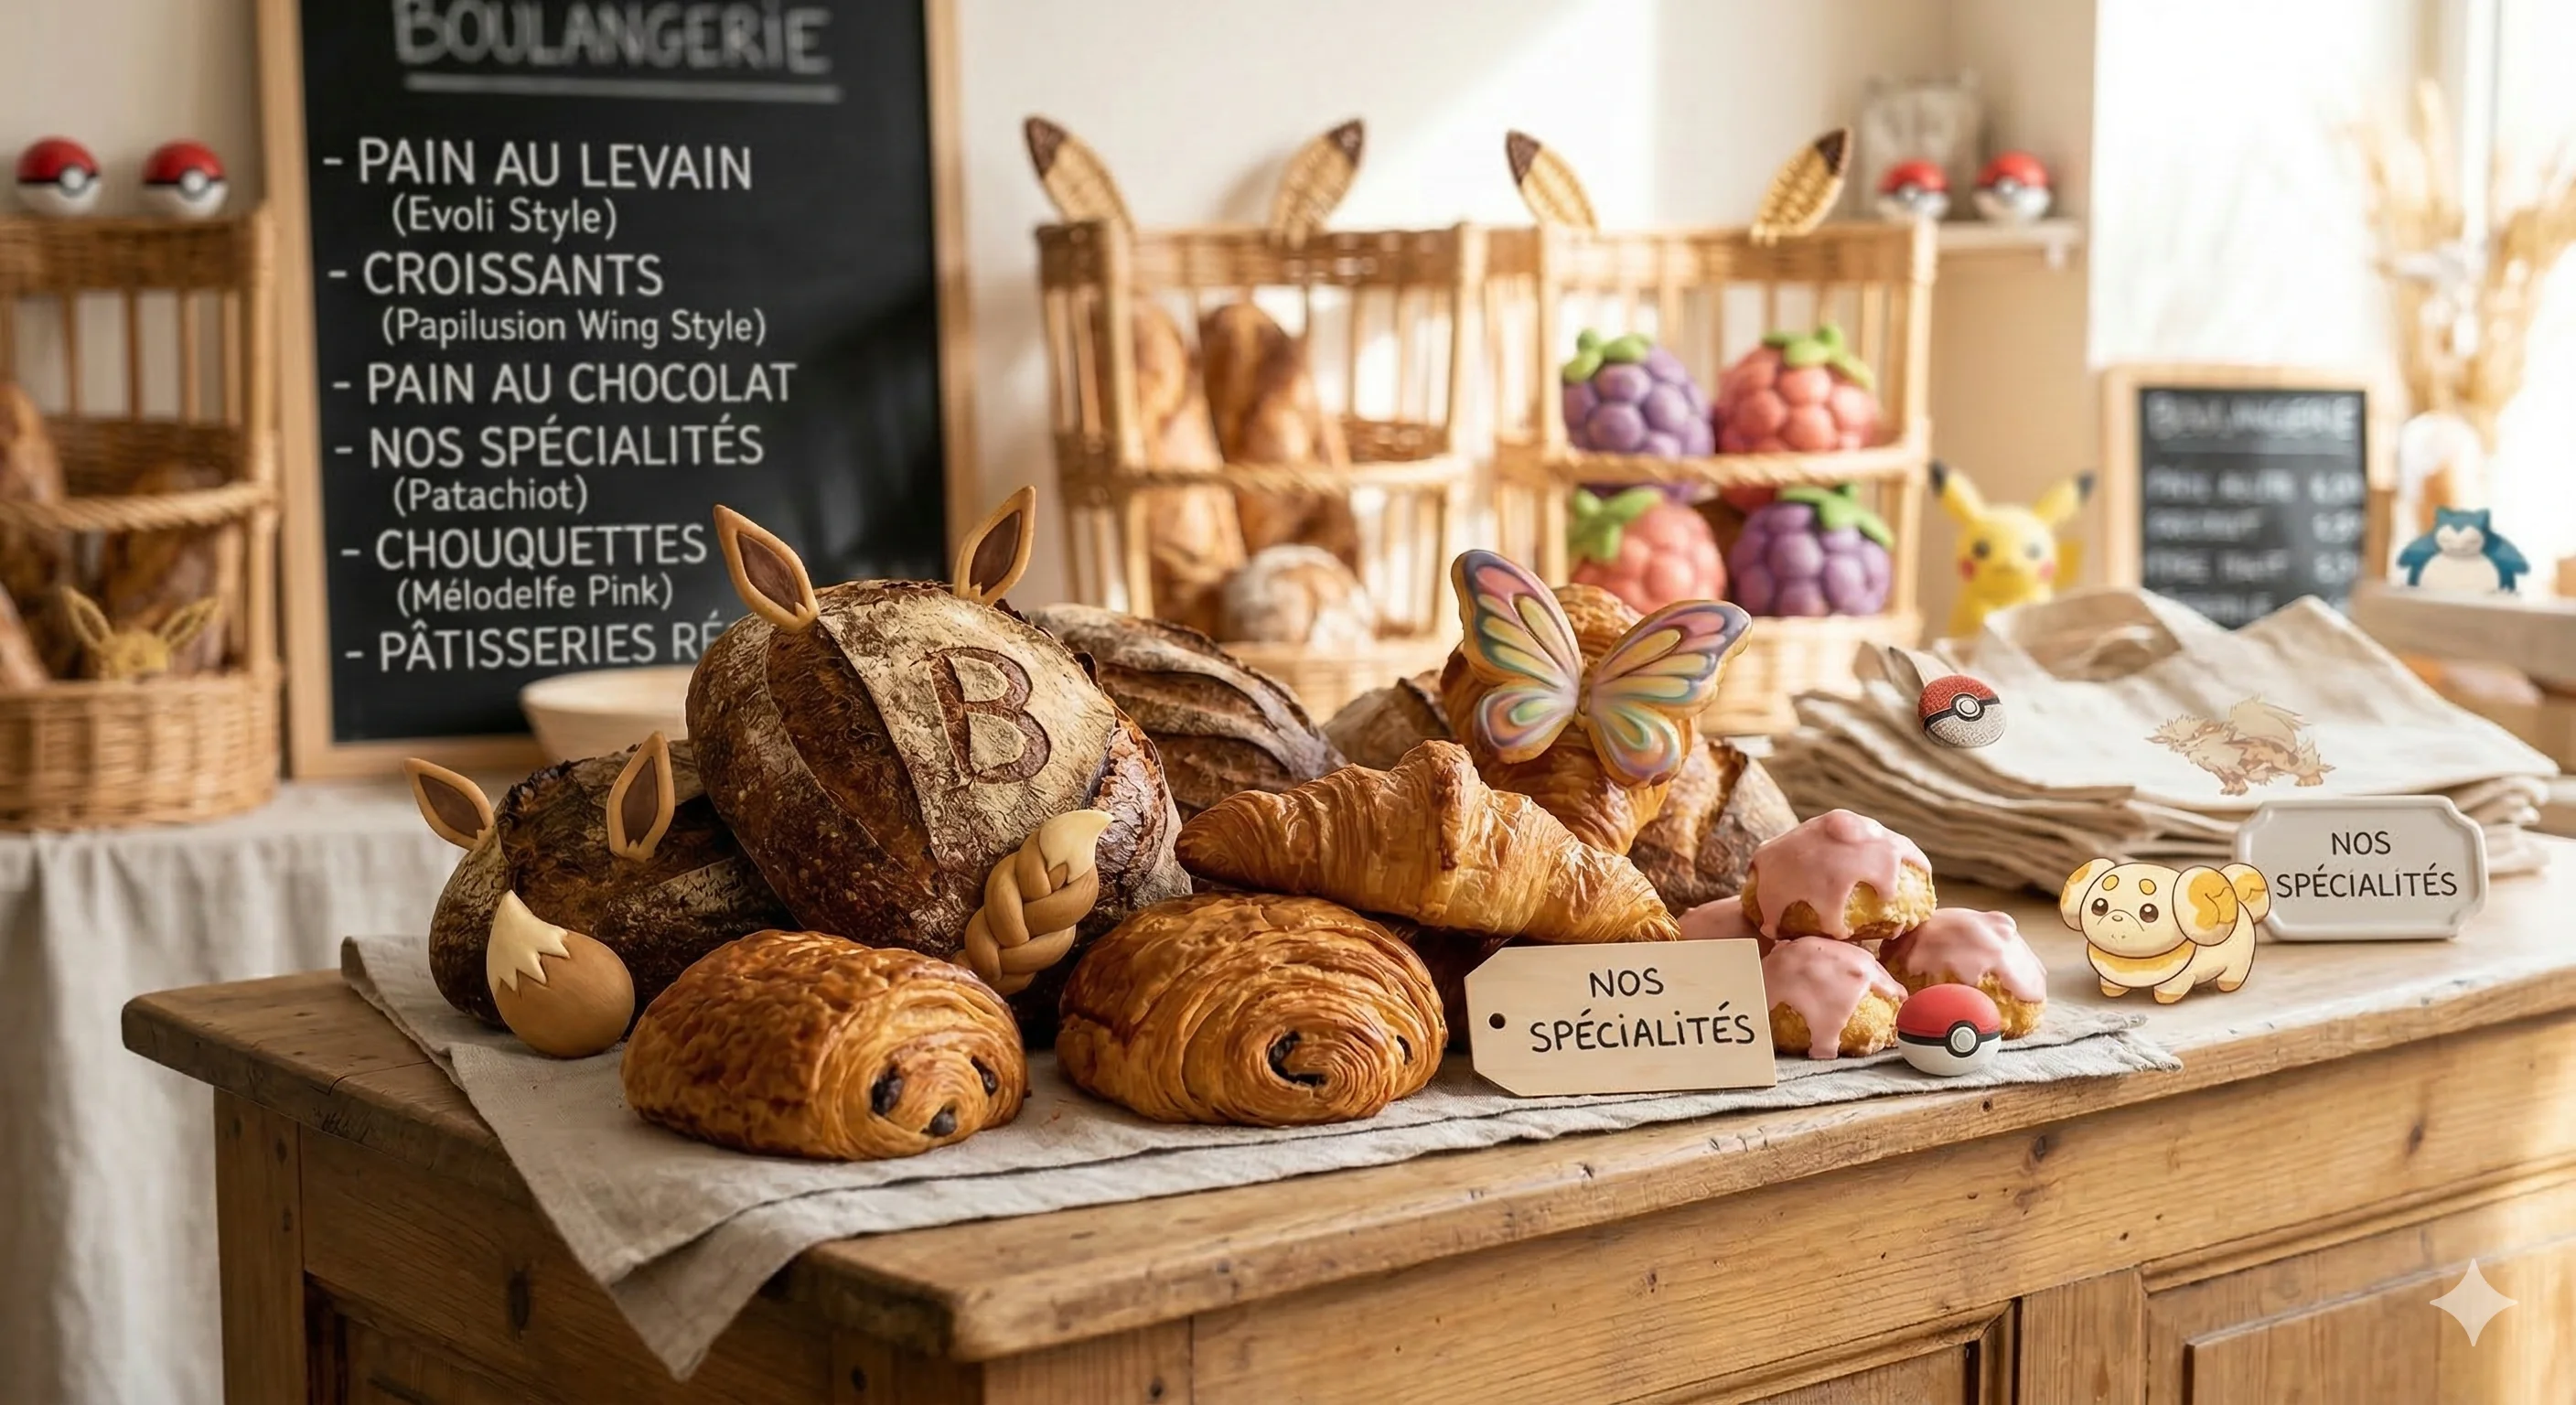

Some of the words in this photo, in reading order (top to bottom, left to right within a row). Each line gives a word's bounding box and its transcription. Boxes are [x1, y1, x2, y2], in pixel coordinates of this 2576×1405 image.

[359, 137, 476, 185] PAIN
[494, 141, 560, 188] AU
[580, 142, 752, 191] LEVAIN
[392, 193, 494, 237] (Evoli
[509, 196, 617, 243] Style)
[363, 251, 664, 297] CROISSANTS
[381, 306, 566, 350] (Papilusion
[576, 307, 660, 351] Wing
[671, 306, 767, 351] Style)
[368, 362, 475, 404] PAIN
[491, 362, 552, 404] AU
[568, 361, 798, 404] CHOCOLAT
[370, 425, 465, 469] NOS
[479, 412, 765, 468] SPÉCIALITÉS
[393, 473, 588, 518] (Patachiot)
[375, 522, 708, 571] CHOUQUETTES
[397, 574, 576, 617] (Mélodelfe
[588, 572, 673, 611] Pink)
[380, 619, 658, 672] PÂTISSERIES
[928, 645, 1053, 785] B
[2330, 830, 2392, 857] NOS
[1588, 966, 1665, 999] NOS
